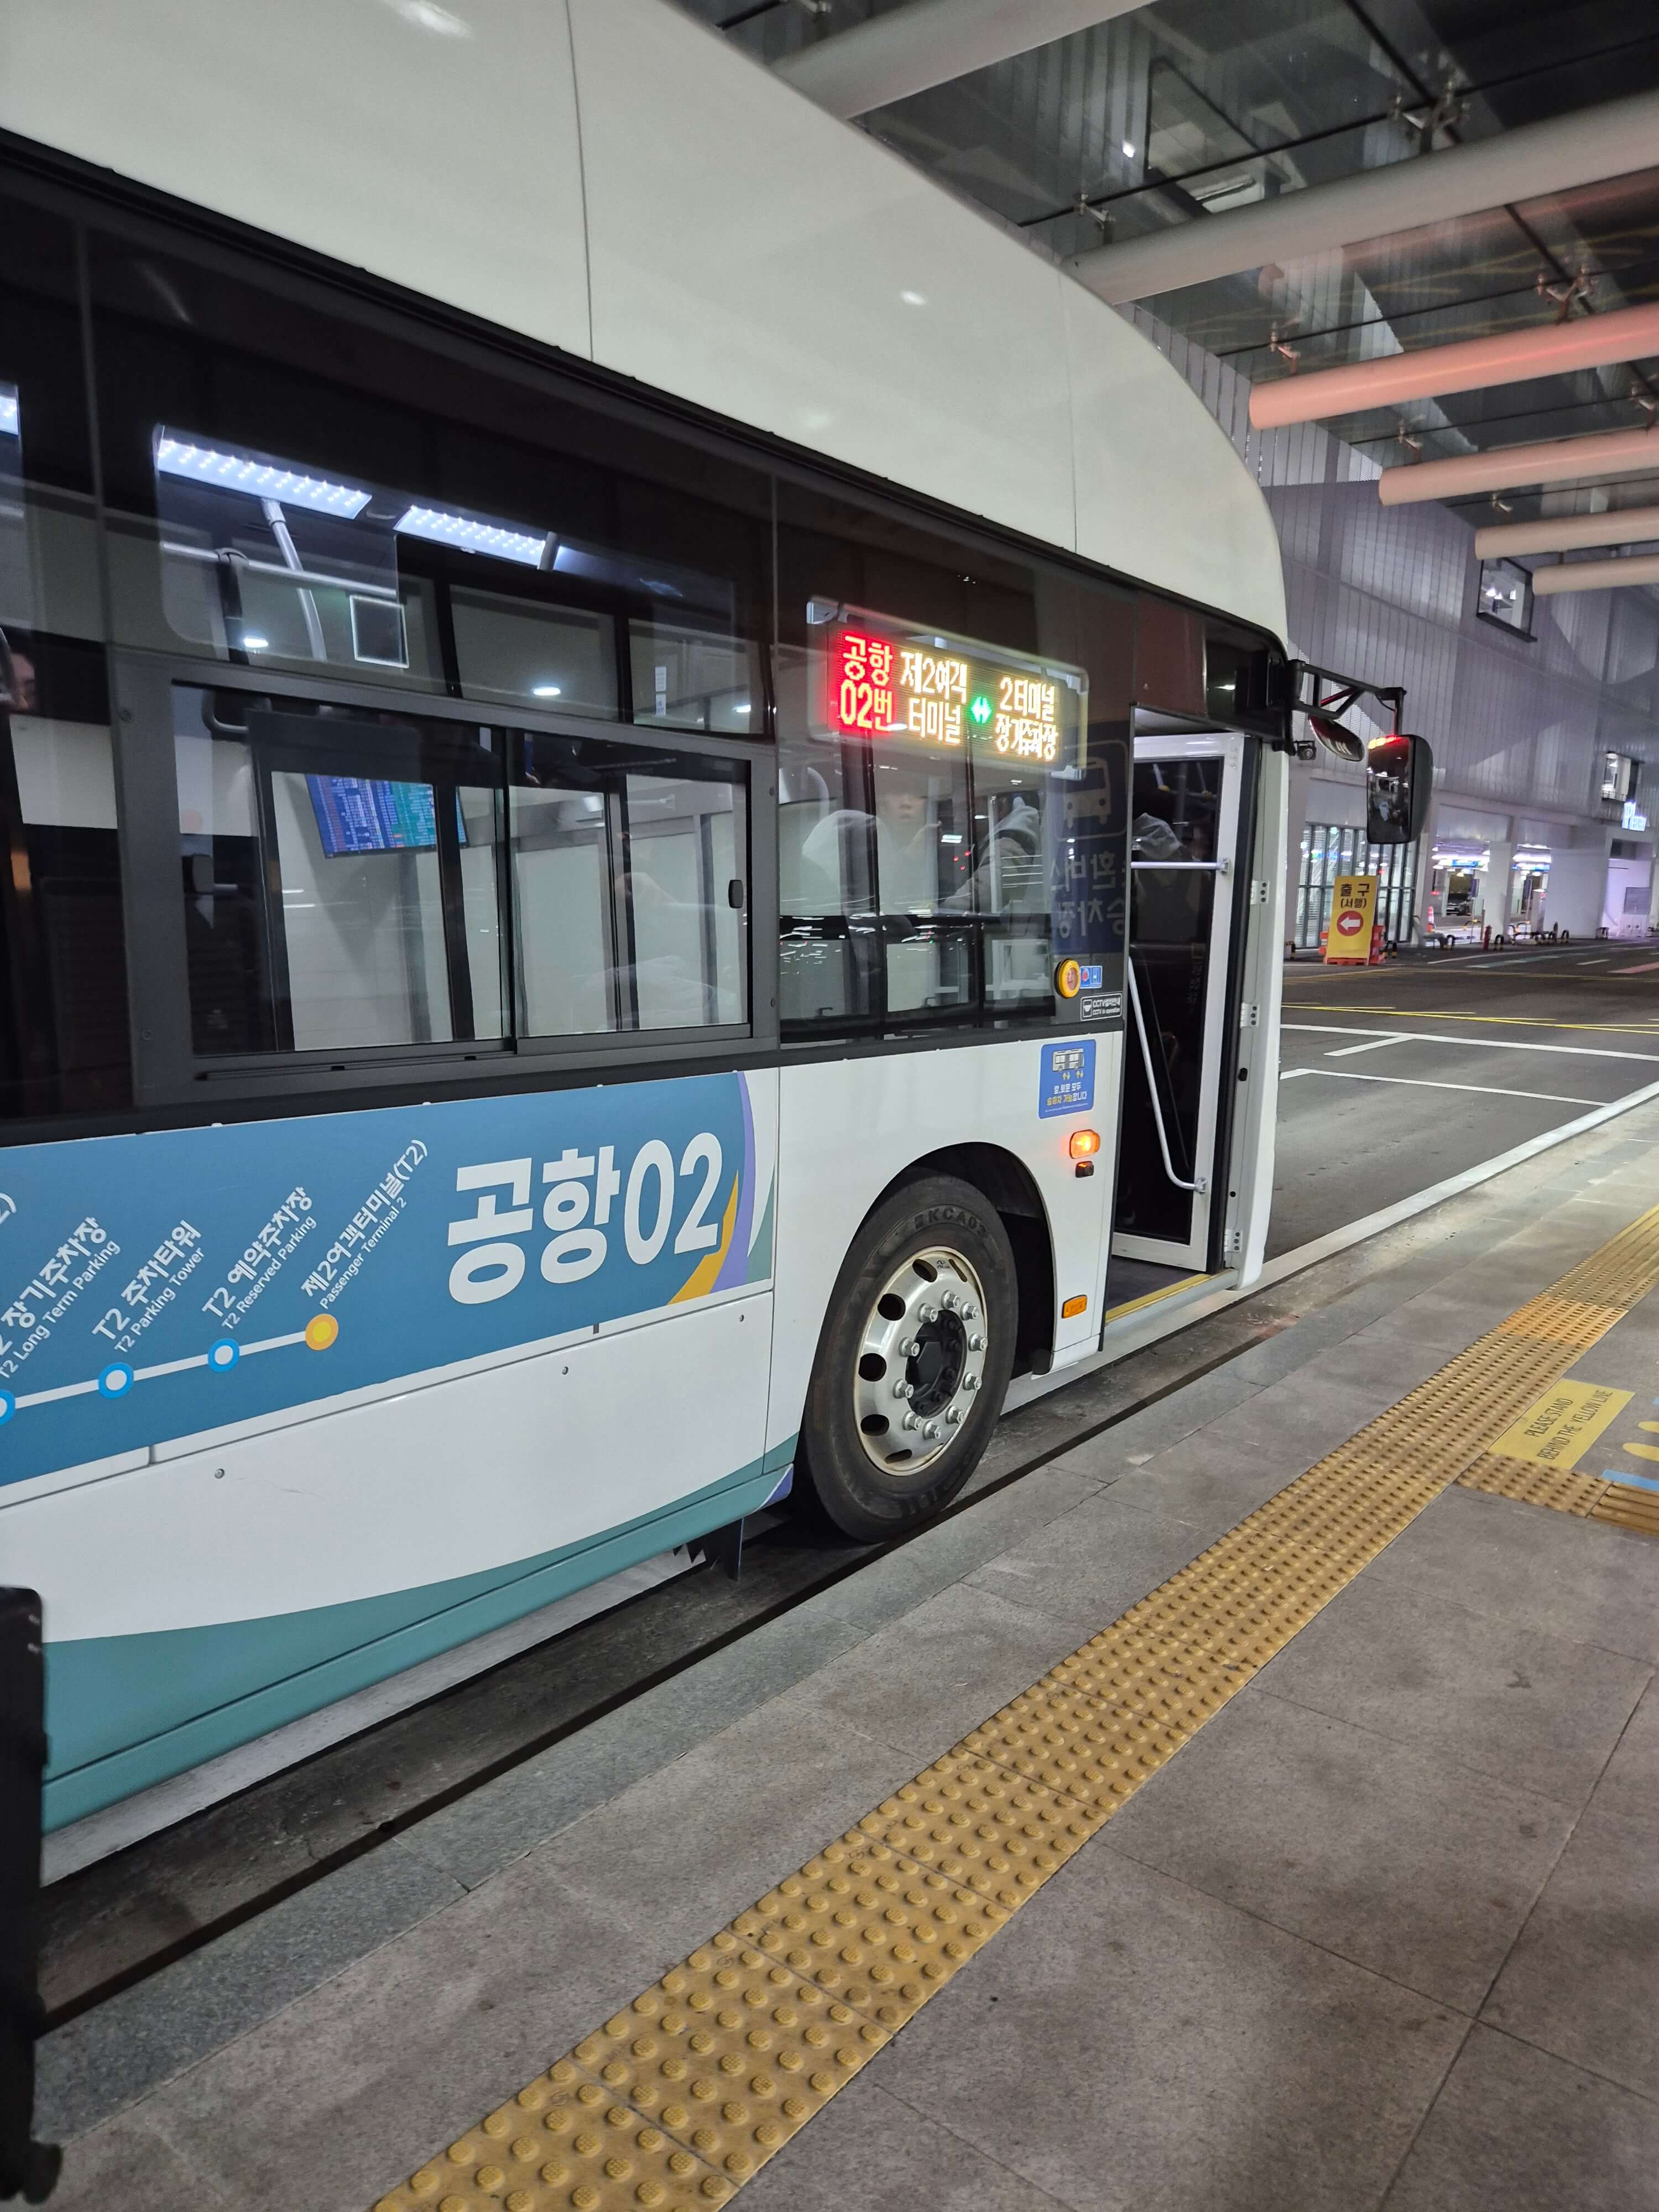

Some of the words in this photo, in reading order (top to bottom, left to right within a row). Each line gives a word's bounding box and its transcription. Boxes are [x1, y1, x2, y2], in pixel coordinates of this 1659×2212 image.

[841, 679, 893, 732] 02번
[843, 635, 893, 686] 공항
[900, 651, 967, 703] 제2여객
[1000, 676, 1055, 722] 2터미널
[909, 697, 961, 743] 터미널
[1071, 1082, 1081, 1092] 모두
[201, 1287, 236, 1317] T2
[227, 1186, 312, 1284] 예약주차장
[300, 1140, 428, 1297] 제2여객터미널(T2)
[319, 1253, 364, 1310] Passenger
[361, 1206, 400, 1253] Terminal
[396, 1197, 406, 1208] 2
[447, 1133, 722, 1305] 공항02
[1, 1217, 107, 1328] 장기주차장
[13, 1324, 51, 1360] Long
[42, 1290, 78, 1323] Term
[72, 1240, 121, 1290] Parking
[92, 1308, 131, 1339] T2
[121, 1220, 201, 1306] 주차타워
[114, 1335, 135, 1353] T2
[130, 1287, 176, 1336] Parking
[169, 1248, 204, 1286] Tower
[221, 1312, 241, 1329] T2
[236, 1258, 282, 1313] Reserved
[277, 1216, 317, 1260] Parking
[1524, 1414, 1557, 1437] PLEASE
[1544, 1397, 1573, 1417] STAND
[1537, 1437, 1571, 1460] BEHIND
[1558, 1424, 1582, 1438] THE
[1572, 1399, 1602, 1424] YELLOW
